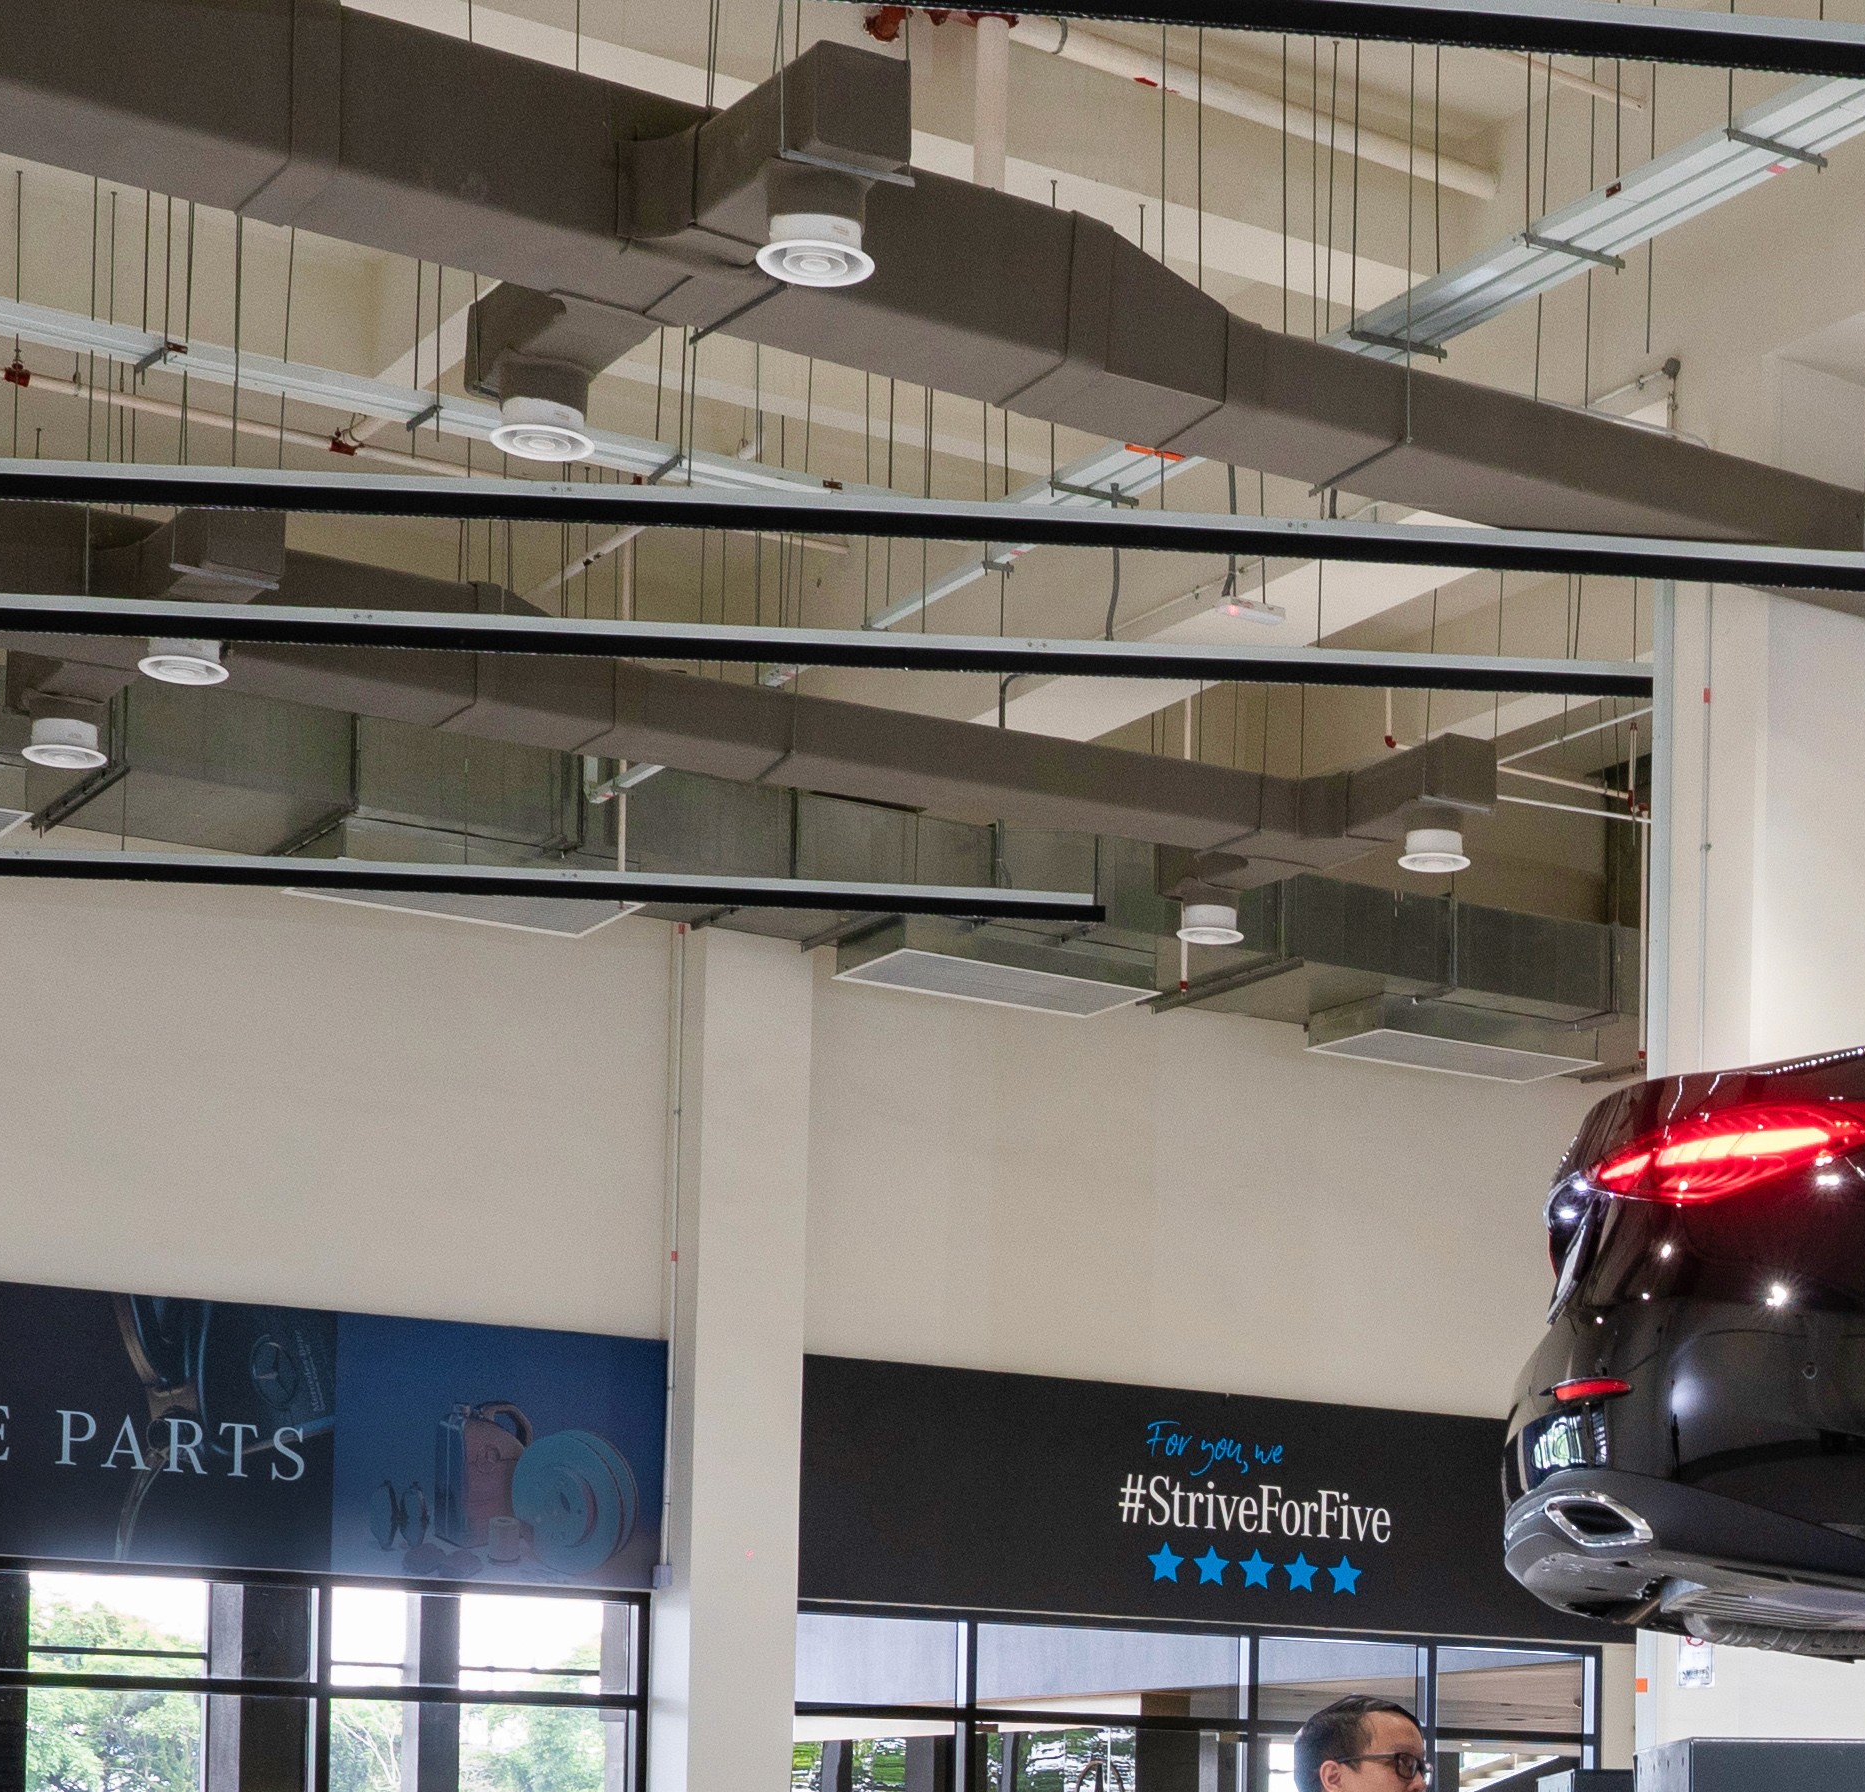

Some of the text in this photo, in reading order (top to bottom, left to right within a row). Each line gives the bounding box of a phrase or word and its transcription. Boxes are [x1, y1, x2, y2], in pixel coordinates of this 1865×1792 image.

[55, 1408, 306, 1483] PARTS
[1145, 1420, 1284, 1477] For you, we
[1118, 1472, 1392, 1544] #StriveForFive
